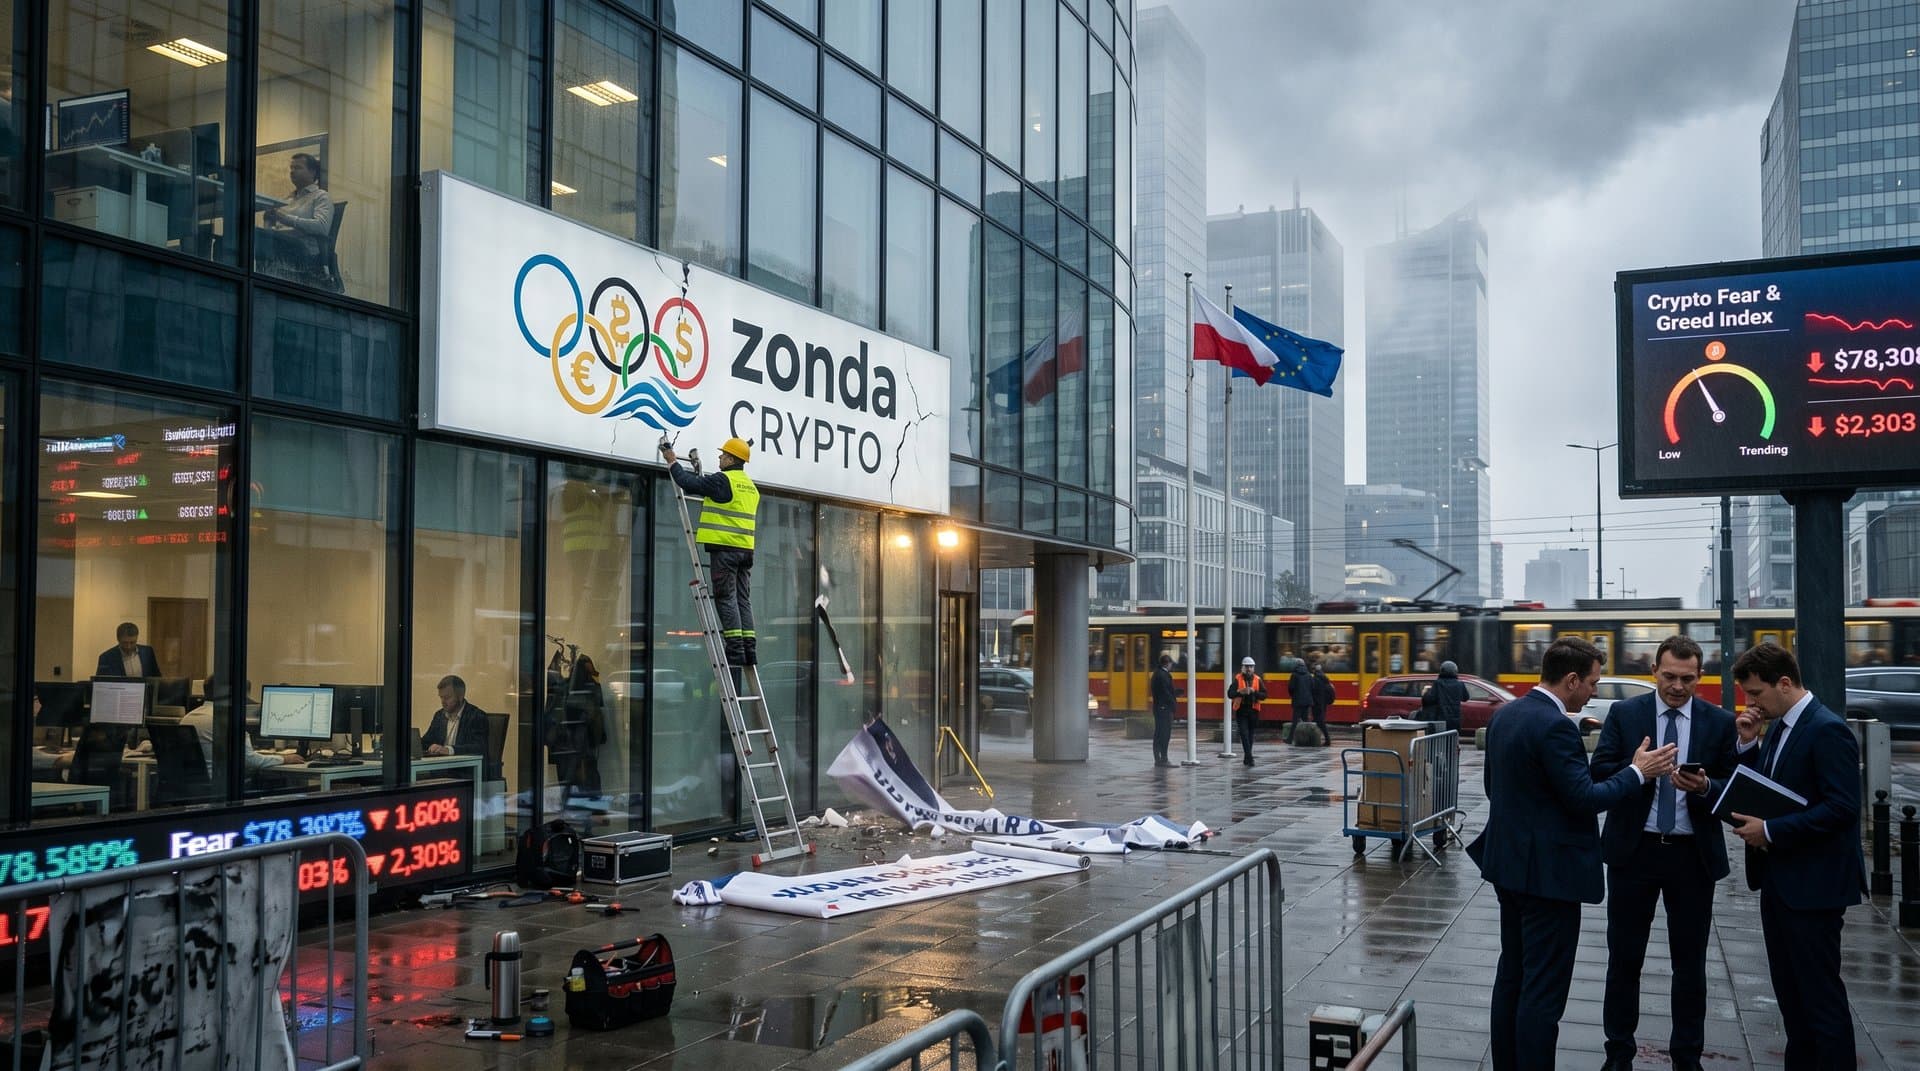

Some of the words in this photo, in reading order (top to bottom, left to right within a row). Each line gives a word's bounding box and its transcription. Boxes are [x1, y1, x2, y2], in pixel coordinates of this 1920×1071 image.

[1648, 291, 1712, 313] Crypto
[1718, 288, 1761, 305] Fear
[1766, 284, 1781, 301] &
[1656, 311, 1714, 332] Greed
[1720, 309, 1774, 328] Index
[731, 318, 897, 420] zonda
[729, 400, 882, 474] CRYPTO
[1835, 412, 1917, 438] $2,303
[1659, 450, 1681, 460] Low
[1739, 444, 1789, 457] Trending
[171, 832, 240, 859] Fear
[395, 797, 460, 832] 1,60%
[390, 839, 460, 877] 2,30%
